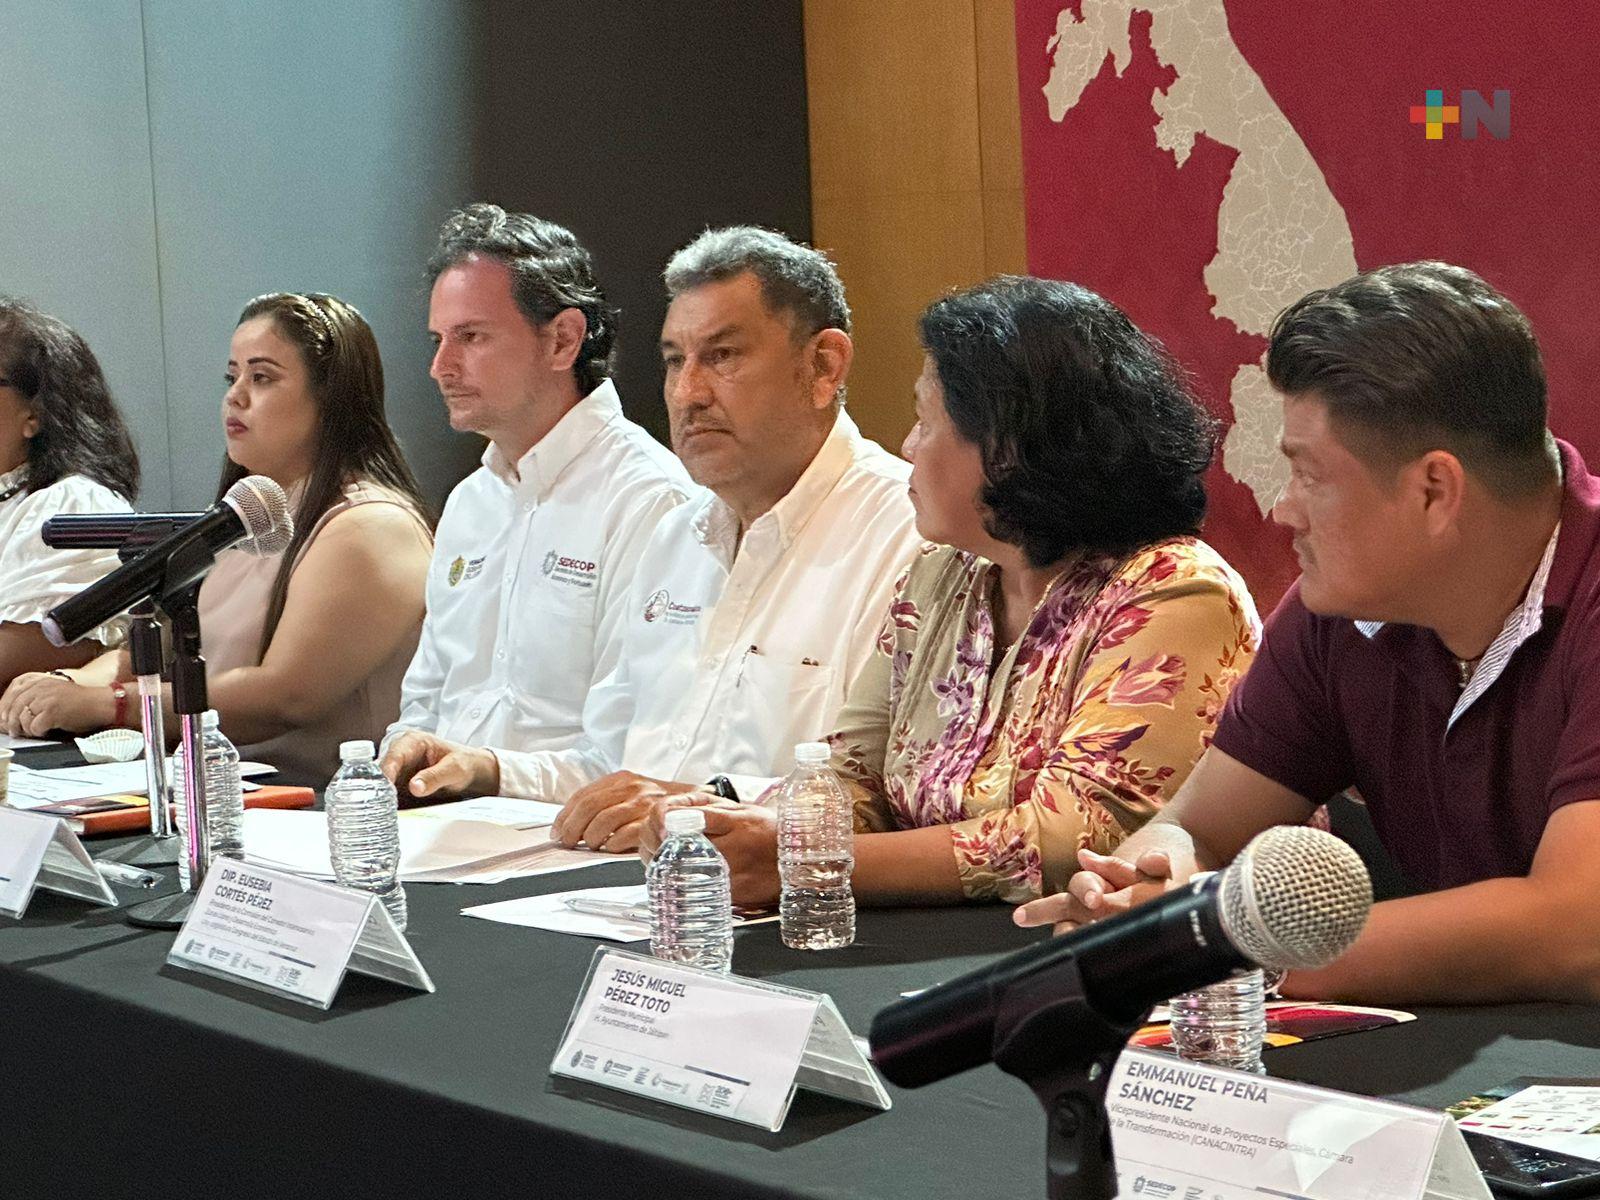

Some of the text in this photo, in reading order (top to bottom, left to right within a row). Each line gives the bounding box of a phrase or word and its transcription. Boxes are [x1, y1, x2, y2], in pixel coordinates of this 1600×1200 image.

[221, 869, 273, 893] DIP. EUSEBIA
[215, 884, 273, 911] CORTÉS PÉREZ
[611, 968, 686, 998] JESÚS MIGUEL
[604, 985, 671, 1013] PÉREZ TOTO
[1119, 1081, 1197, 1112] SÁNCHEZ
[1127, 1061, 1268, 1104] EMMANUEL PEÑA
[1111, 1103, 1171, 1124] Vicepresidente
[1171, 1115, 1209, 1133] Nacional
[1210, 1123, 1225, 1136] de
[1225, 1127, 1267, 1146] Proyectos
[1116, 1117, 1125, 1128] la
[1126, 1119, 1190, 1141] Transformación
[1190, 1134, 1256, 1159] (CANACINTRA)
